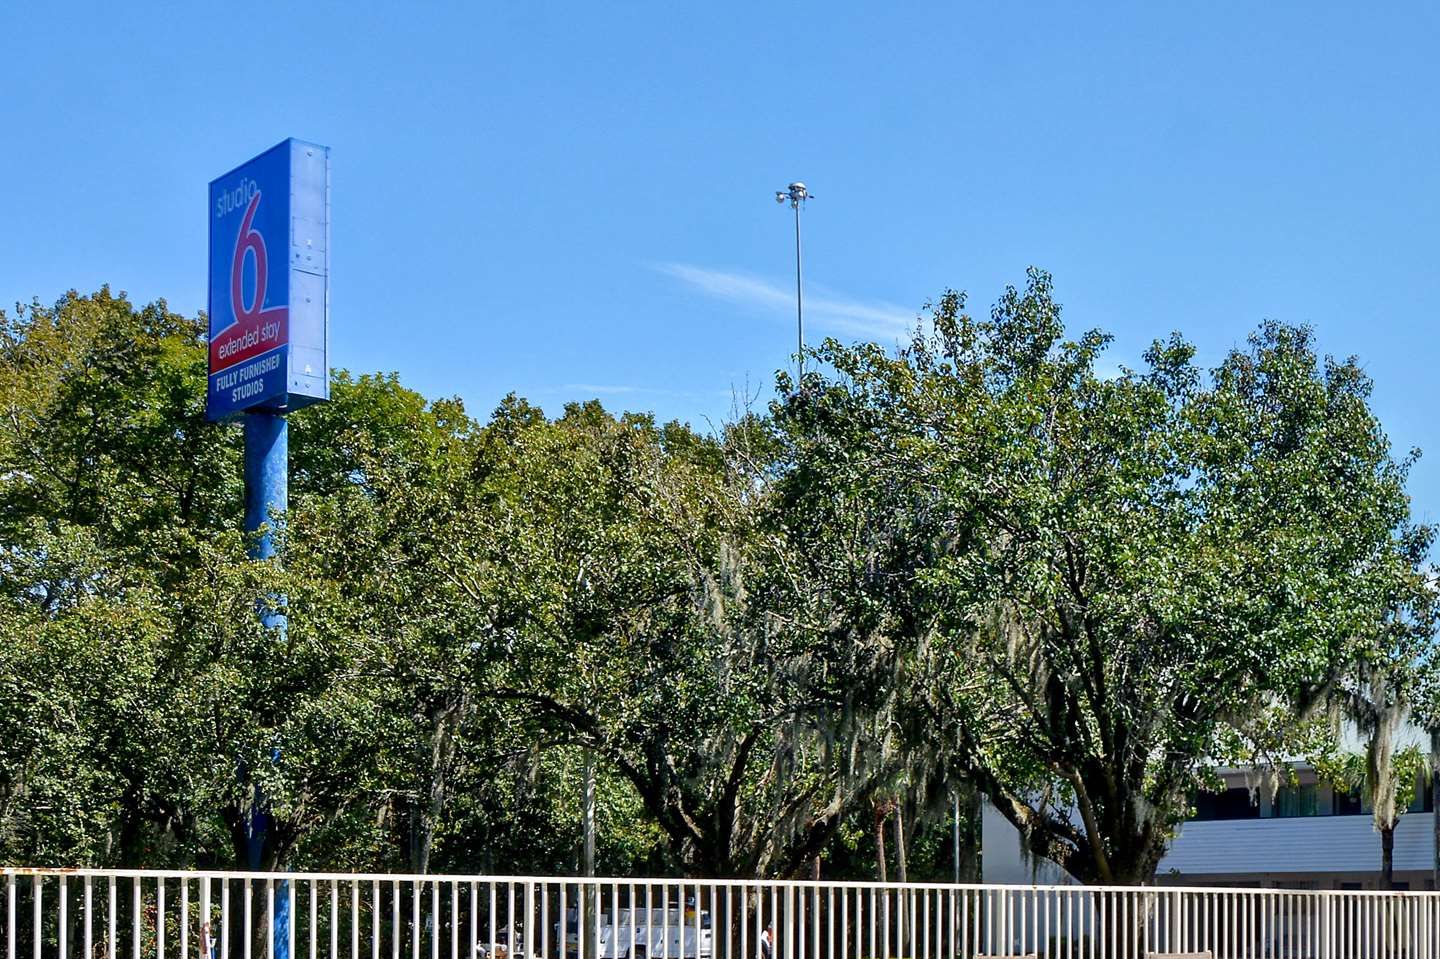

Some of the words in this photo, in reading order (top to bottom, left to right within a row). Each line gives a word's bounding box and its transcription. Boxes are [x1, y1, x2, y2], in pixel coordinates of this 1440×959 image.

[217, 177, 257, 218] studio
[230, 189, 268, 318] 6
[219, 324, 259, 360] extended
[261, 321, 281, 342] stay
[216, 371, 239, 392] FULLY
[232, 378, 264, 403] STUDIOS
